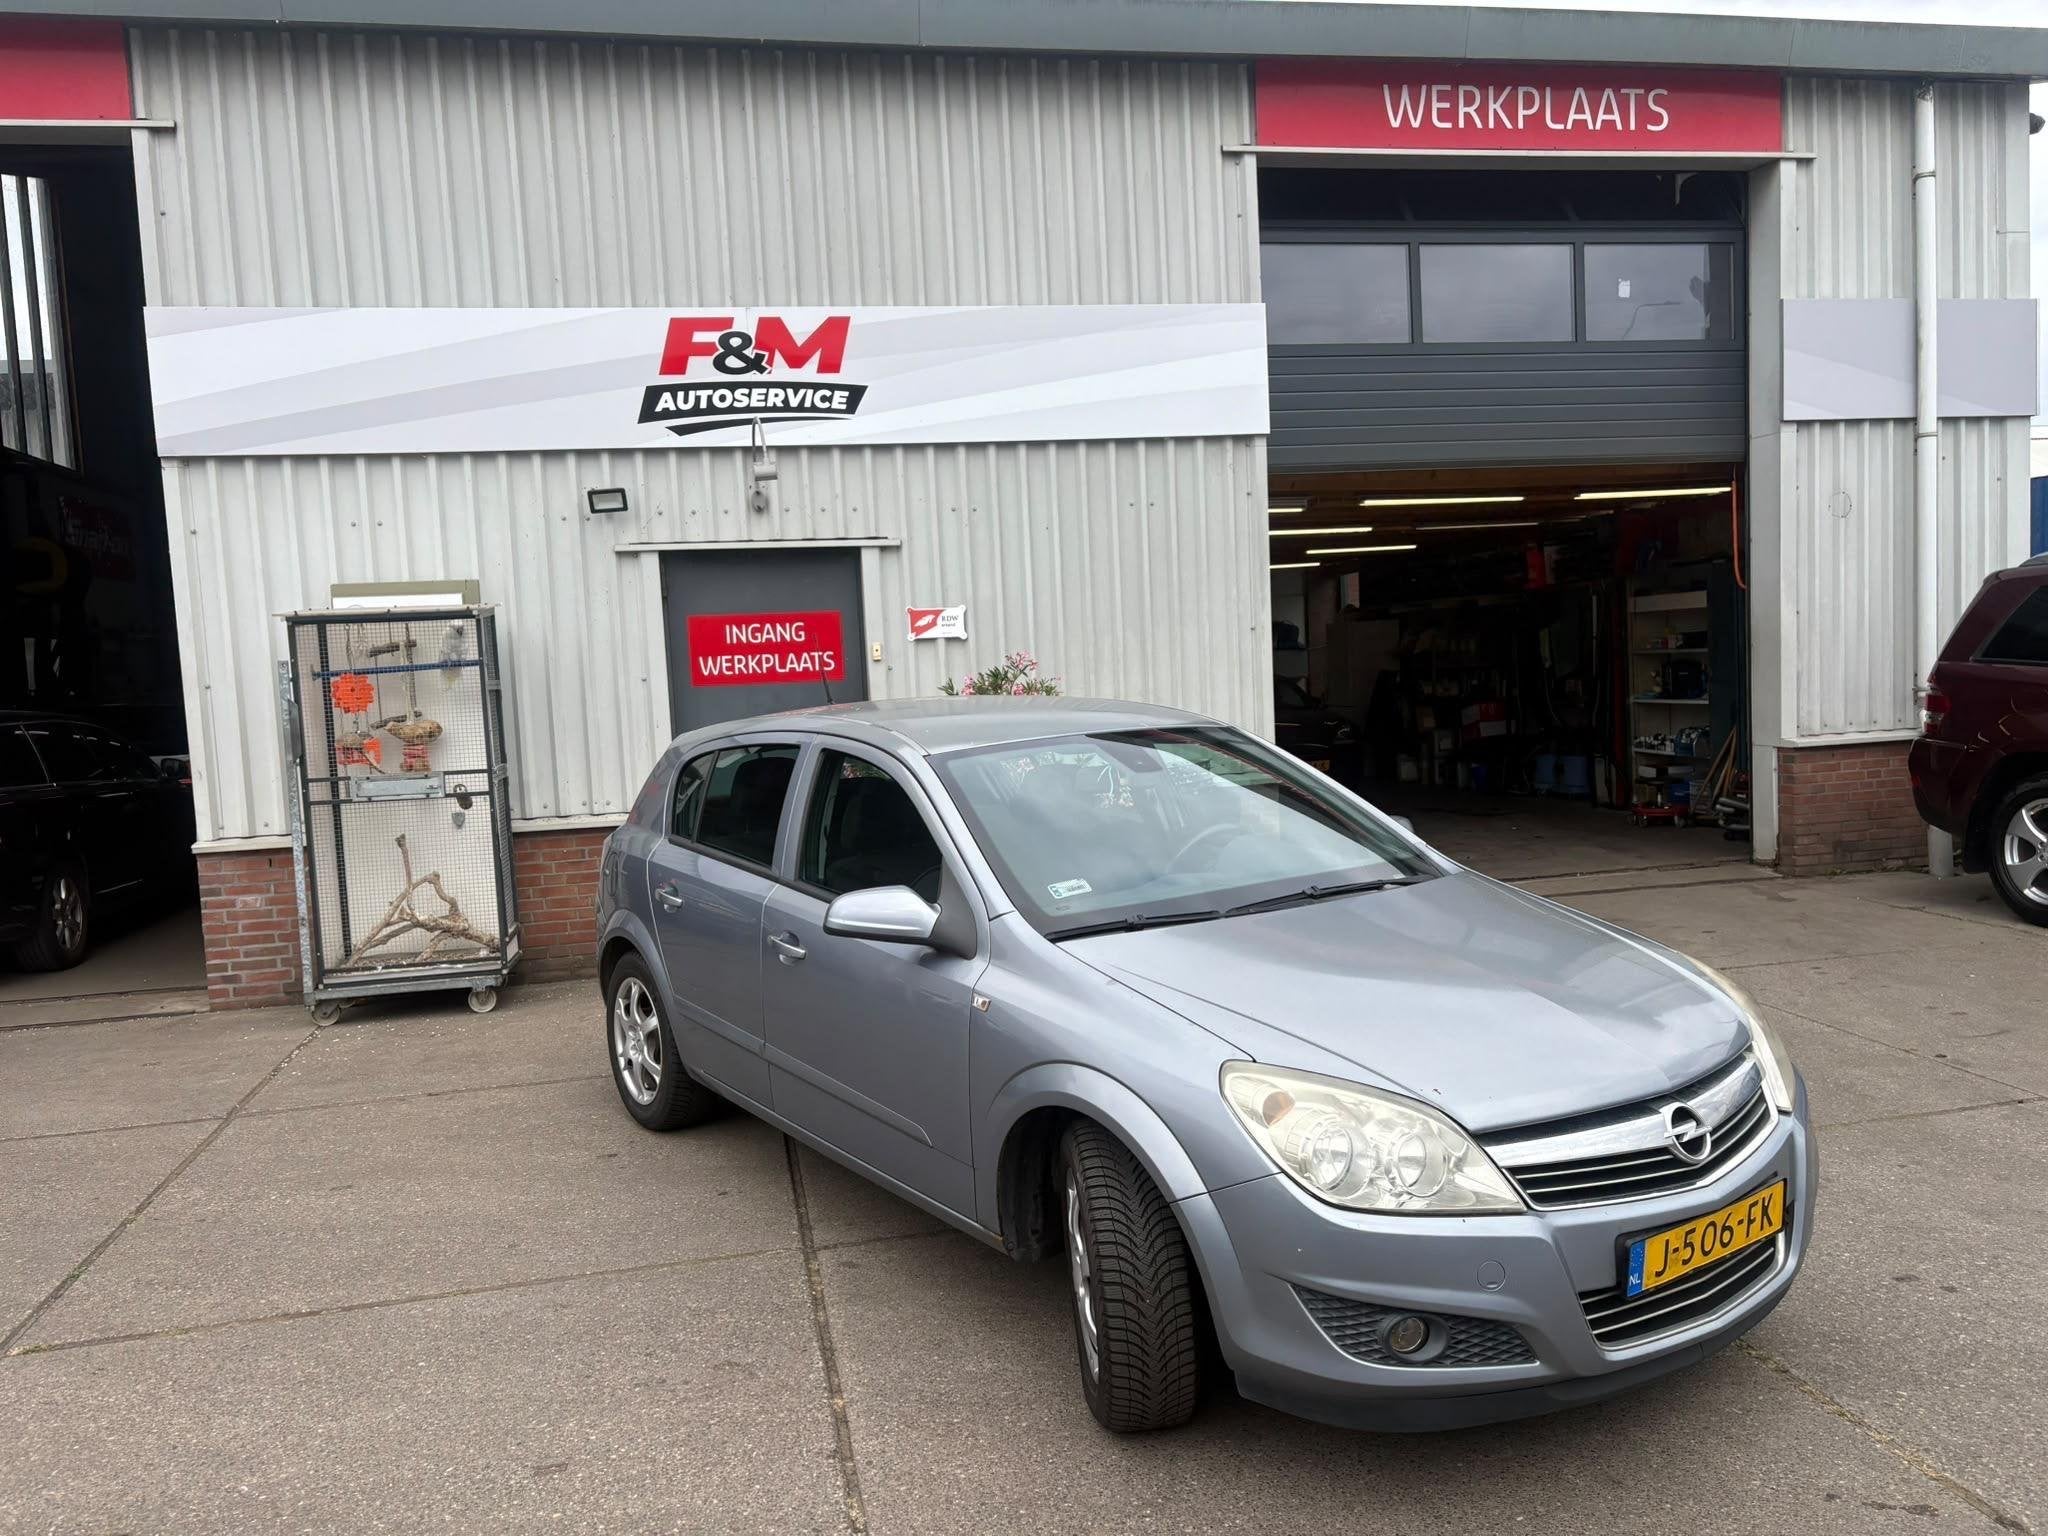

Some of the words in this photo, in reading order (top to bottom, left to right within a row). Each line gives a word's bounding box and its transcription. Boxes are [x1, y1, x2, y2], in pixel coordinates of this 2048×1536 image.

[1383, 84, 1669, 131] WERKPLAATS
[659, 316, 851, 375] F&M
[655, 388, 849, 412] AUTOSERVICE
[725, 622, 805, 644] INGANG
[699, 651, 835, 676] WERKPLAATS
[1655, 1193, 1774, 1278] J-506-FK
[1630, 1272, 1641, 1286] NL
